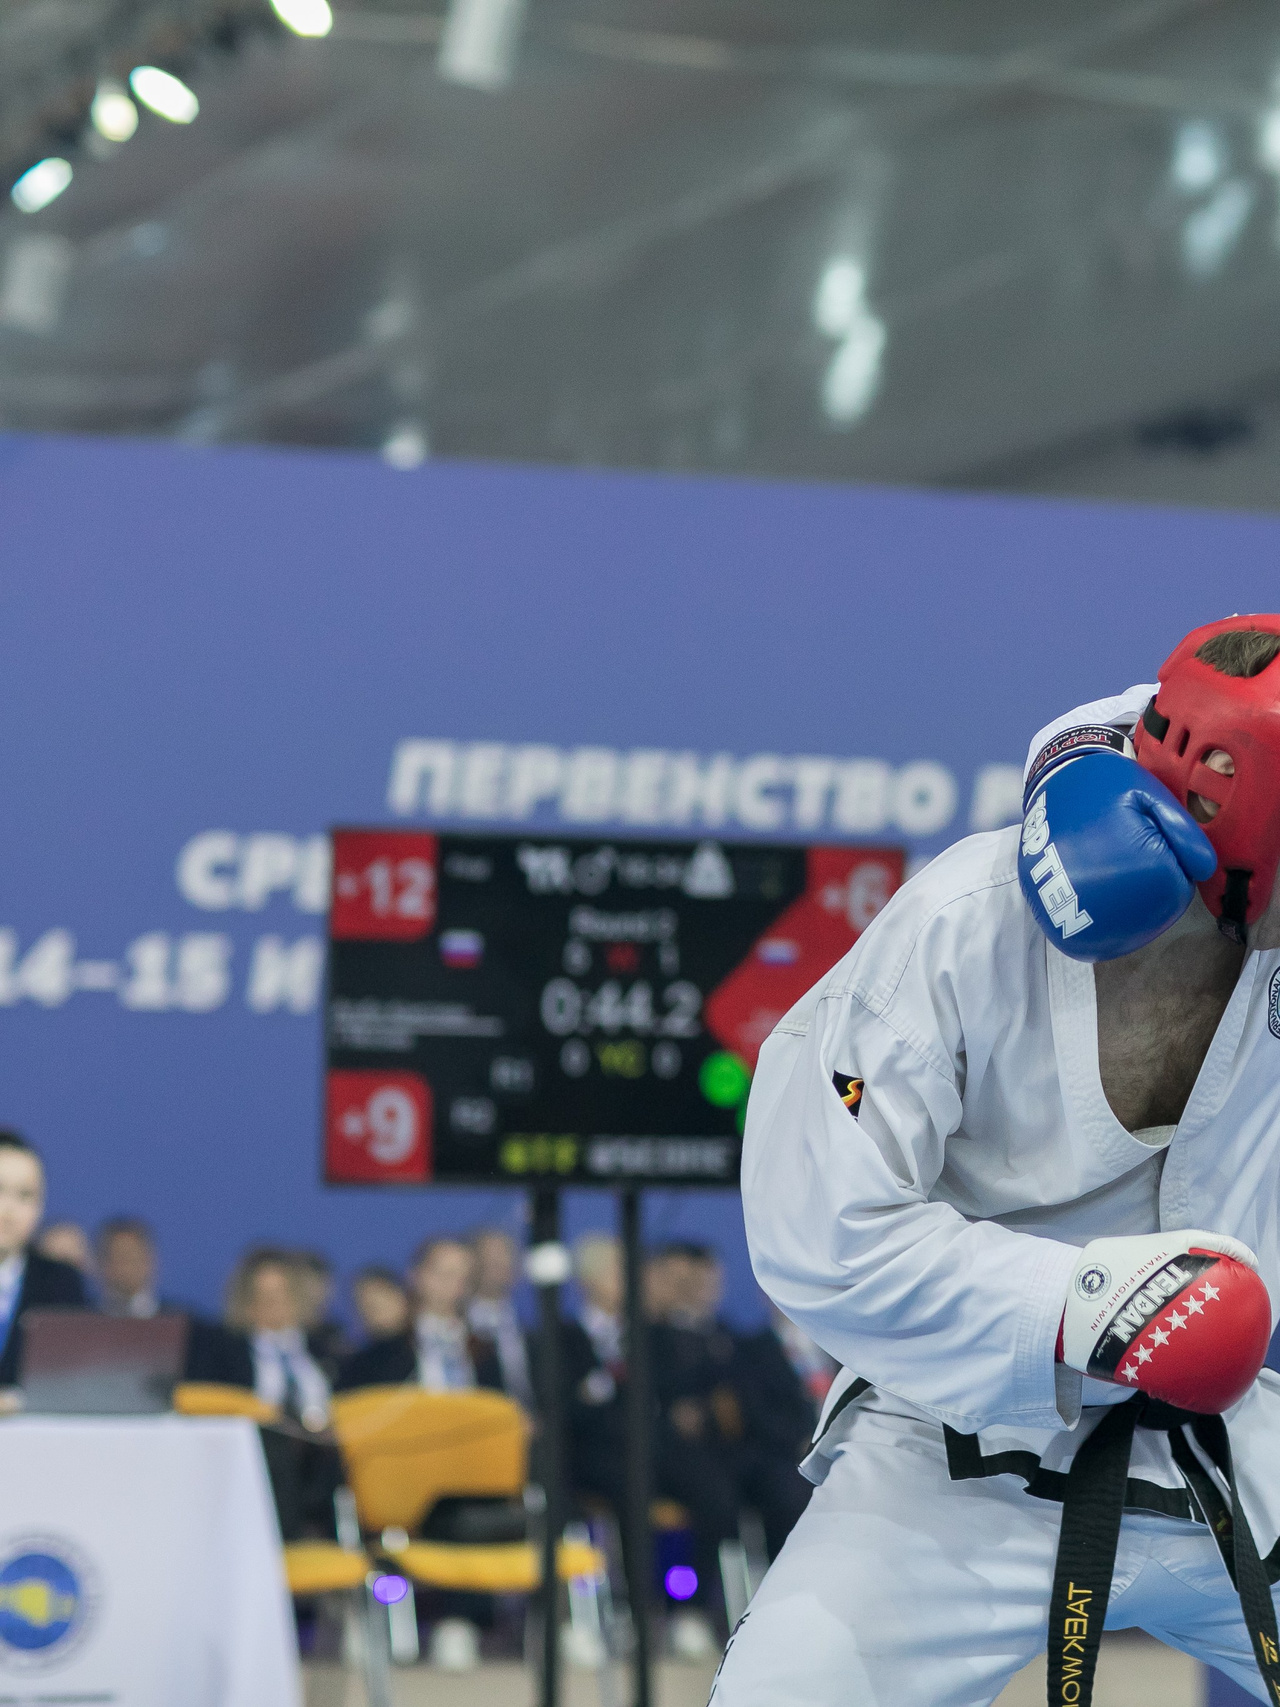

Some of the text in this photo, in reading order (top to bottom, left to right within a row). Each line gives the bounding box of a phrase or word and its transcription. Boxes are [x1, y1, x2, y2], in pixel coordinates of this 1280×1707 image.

[1062, 733, 1111, 747] TOP
[391, 739, 957, 835] ПЕРВЕНСТВО
[1030, 842, 1094, 940] TEN
[1110, 1262, 1193, 1344] TENDAN
